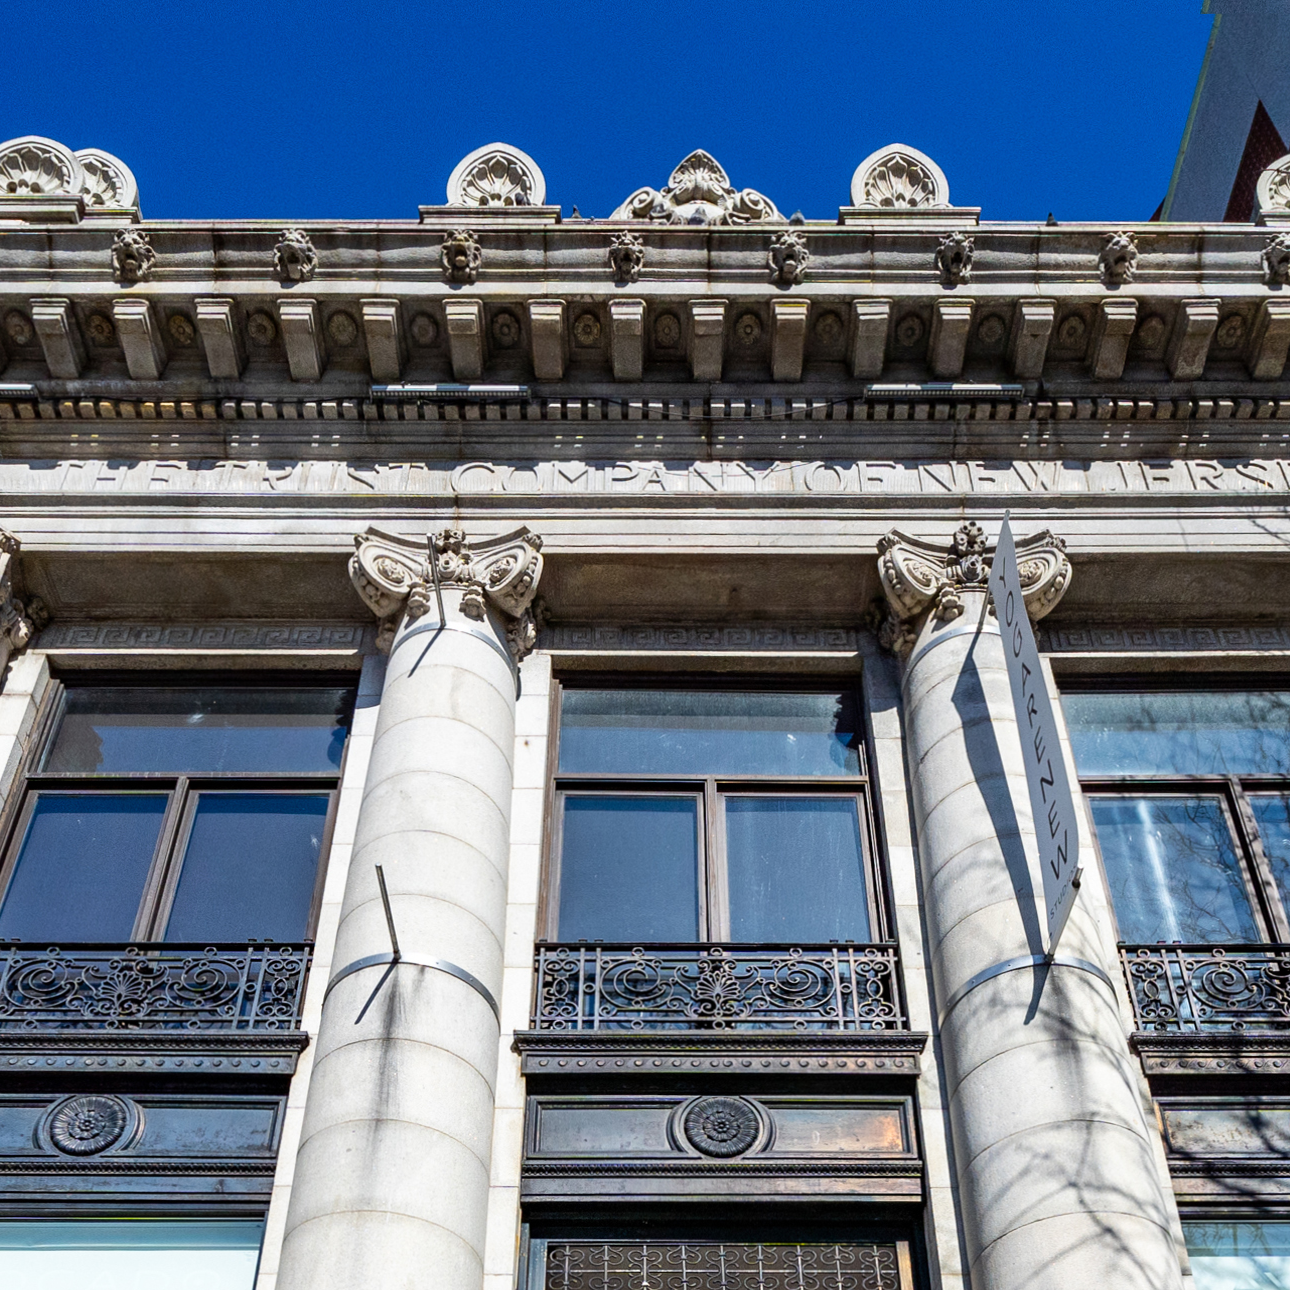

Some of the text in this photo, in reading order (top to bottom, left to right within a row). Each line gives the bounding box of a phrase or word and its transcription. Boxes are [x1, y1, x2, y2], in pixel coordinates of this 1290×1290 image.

[57, 460, 188, 491] THE
[215, 460, 427, 491] TRUST
[451, 461, 785, 492] COMPANY
[805, 461, 897, 492] OF
[918, 459, 1064, 492] NEW
